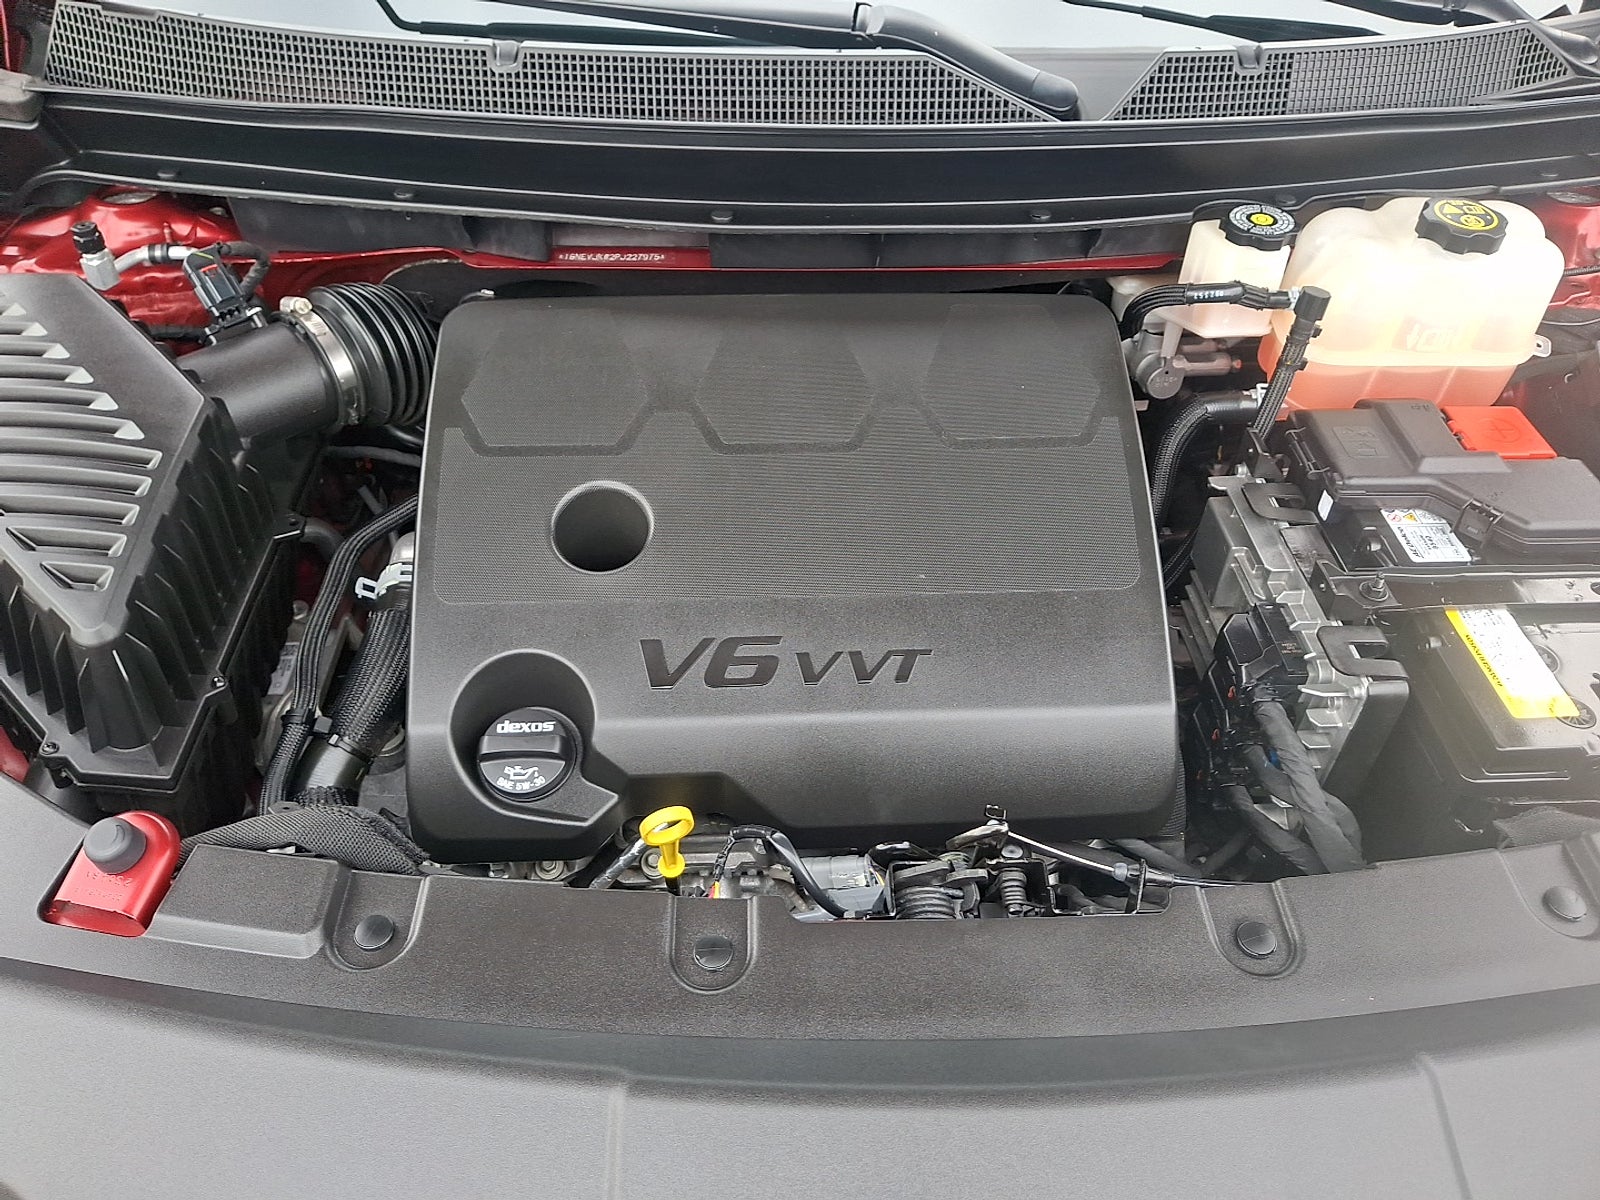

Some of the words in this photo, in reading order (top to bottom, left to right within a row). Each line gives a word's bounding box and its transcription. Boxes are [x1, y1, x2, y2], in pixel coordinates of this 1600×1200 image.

[639, 636, 782, 690] V6
[795, 648, 933, 686] VVT
[496, 719, 556, 734] dexos
[496, 776, 515, 790] SAE
[515, 775, 546, 790] 5W-30
